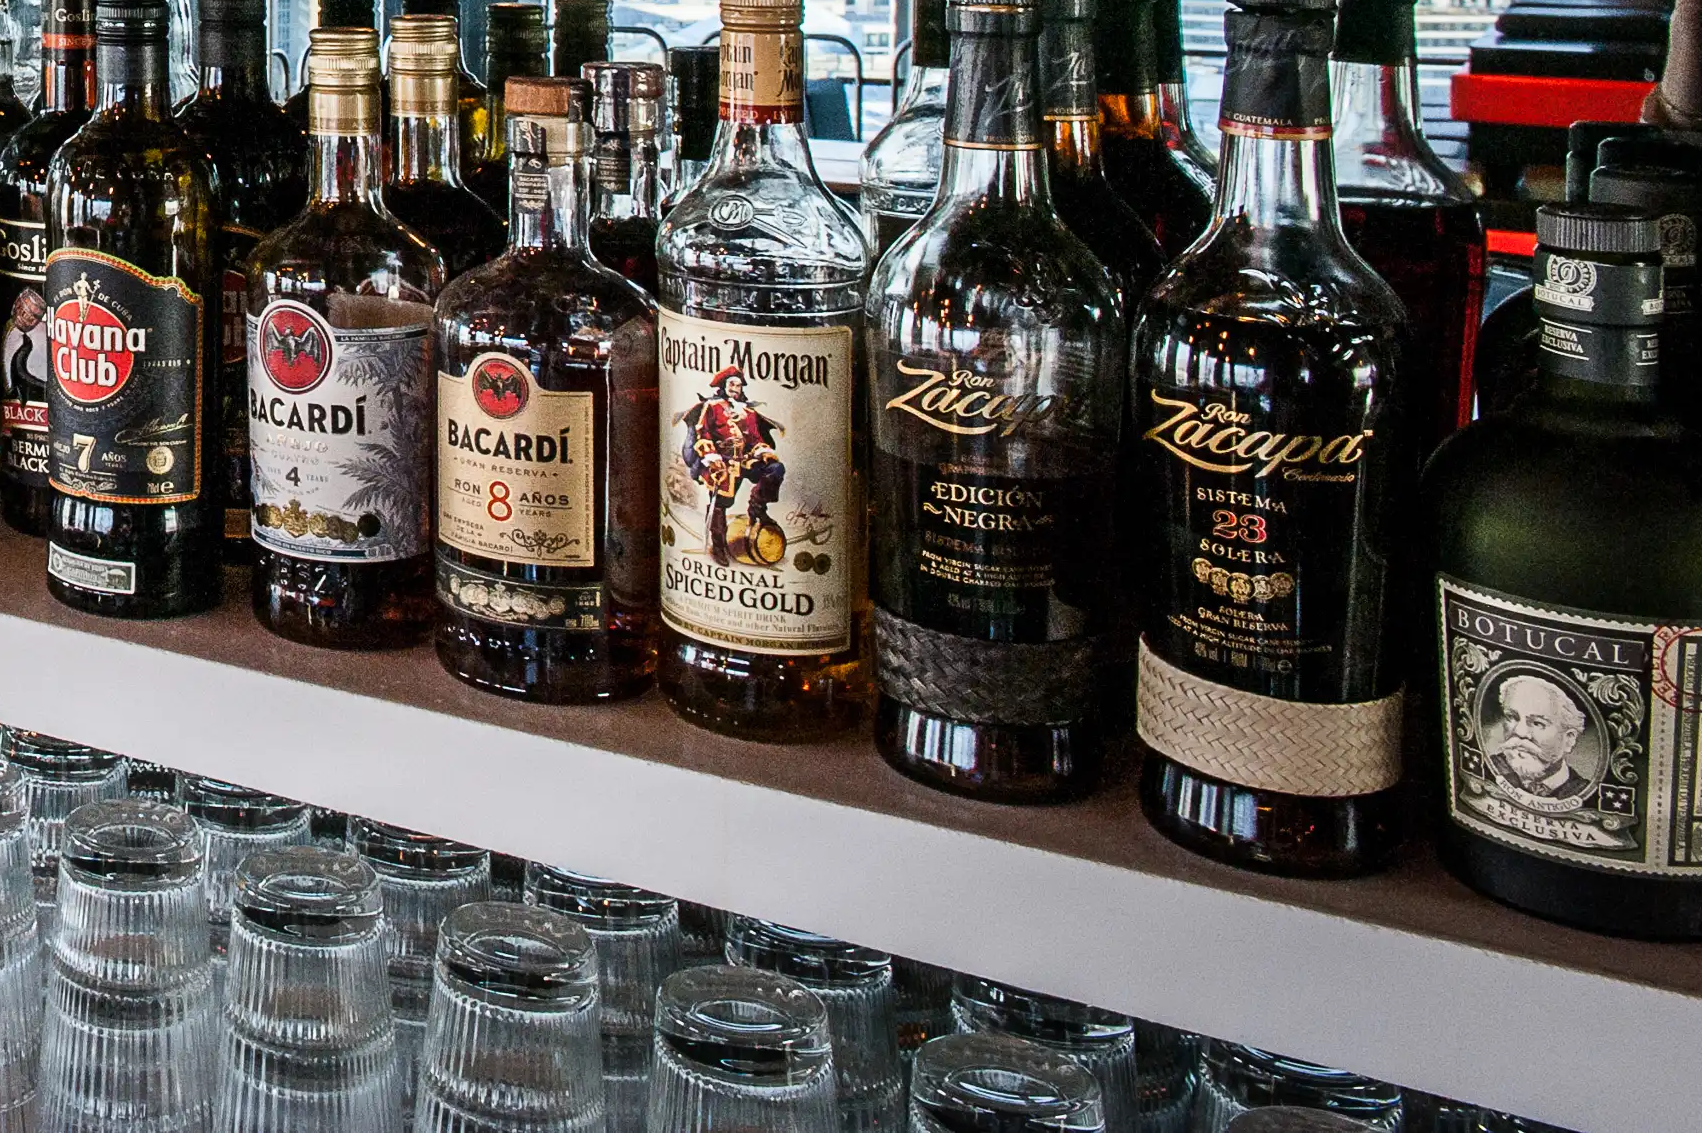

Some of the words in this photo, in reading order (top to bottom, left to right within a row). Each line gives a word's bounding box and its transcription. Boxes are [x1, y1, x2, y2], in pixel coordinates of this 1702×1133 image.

[1233, 113, 1294, 127] GUATEMALA
[98, 292, 111, 303] DE
[111, 300, 133, 322] CUBA
[46, 306, 146, 353] Havana
[1544, 324, 1579, 343] RESERVA
[1541, 334, 1584, 354] EXCLUSIVA
[57, 347, 118, 387] Club
[661, 326, 721, 374] Captain
[724, 339, 829, 390] Morgan
[948, 369, 995, 389] Ron
[4, 405, 46, 423] BLACK
[250, 388, 368, 436] BACARDÍ
[1200, 402, 1251, 425] Ron
[447, 418, 570, 464] BACARDÍ
[1141, 388, 1364, 479] Zacapa
[8, 452, 50, 474] BLACK
[73, 433, 96, 473] 7
[101, 451, 127, 463] AÑOS
[285, 466, 301, 487] 4
[491, 464, 548, 479] RESERVA
[454, 478, 482, 495] RON
[486, 480, 513, 522] 8
[519, 491, 570, 506] AÑOS
[930, 481, 1044, 508] EDICIÓN
[1196, 487, 1288, 515] SISTEMA
[943, 504, 1034, 531] NEGRA
[1212, 509, 1267, 543] 23
[944, 556, 971, 569] VIRGIN
[1199, 538, 1286, 564] SOLERA
[681, 557, 784, 589] ORIGINAL
[665, 563, 734, 603] SPICED
[739, 587, 815, 616] GOLD
[722, 607, 754, 620] SPIRIT
[755, 612, 786, 624] DRINK
[727, 617, 743, 628] and
[746, 620, 770, 632] other
[772, 622, 805, 633] Natural
[1197, 606, 1230, 625] GRAN
[1233, 618, 1291, 632] RESERVA
[1218, 605, 1265, 622] SOLERA
[698, 627, 743, 645] CAPTAIN
[1228, 632, 1257, 645] SUGAR
[1457, 607, 1631, 666] BOTUCAL
[1500, 779, 1523, 801] RON
[1528, 797, 1581, 812] ANTIGUO
[1486, 803, 1598, 842] EXCLUSIVA
[1498, 798, 1580, 831] RESERVA
